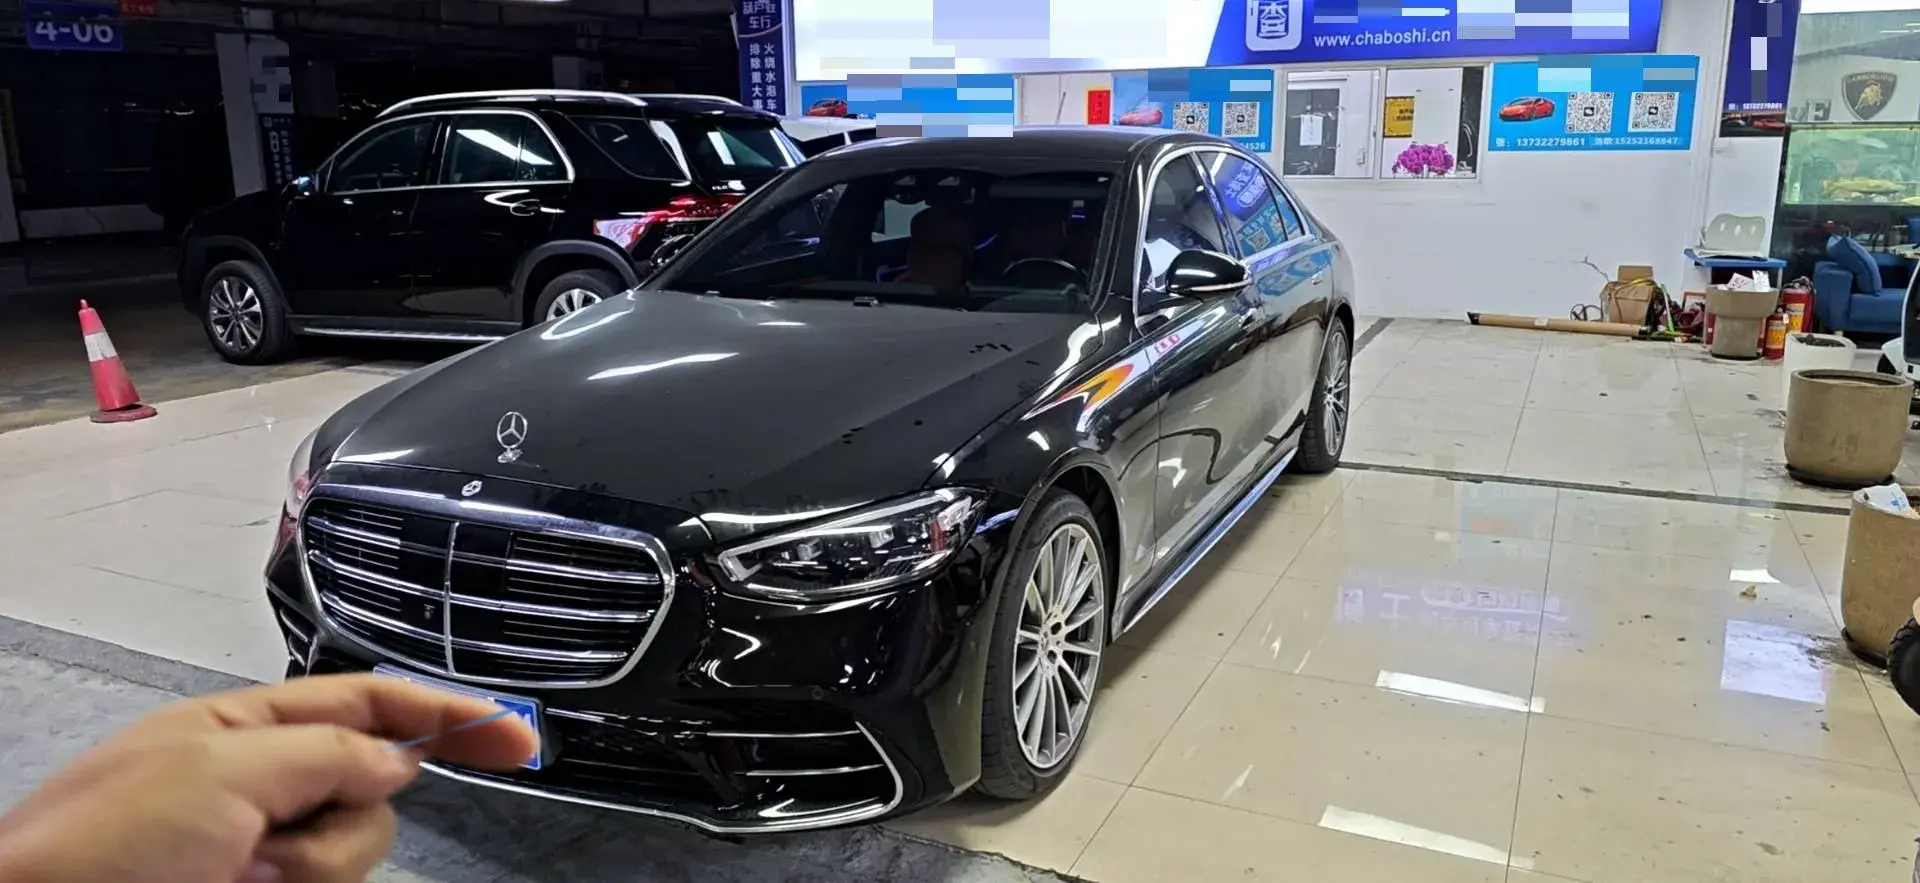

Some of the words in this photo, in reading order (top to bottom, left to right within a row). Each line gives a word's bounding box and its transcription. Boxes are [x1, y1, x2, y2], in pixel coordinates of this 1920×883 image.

[35, 13, 114, 43] 4-06
[749, 15, 772, 29] 车行
[1313, 28, 1451, 47] www.chaboshi.cn
[763, 43, 777, 110] 火烧水泡车
[1516, 137, 1586, 147] 13732279861
